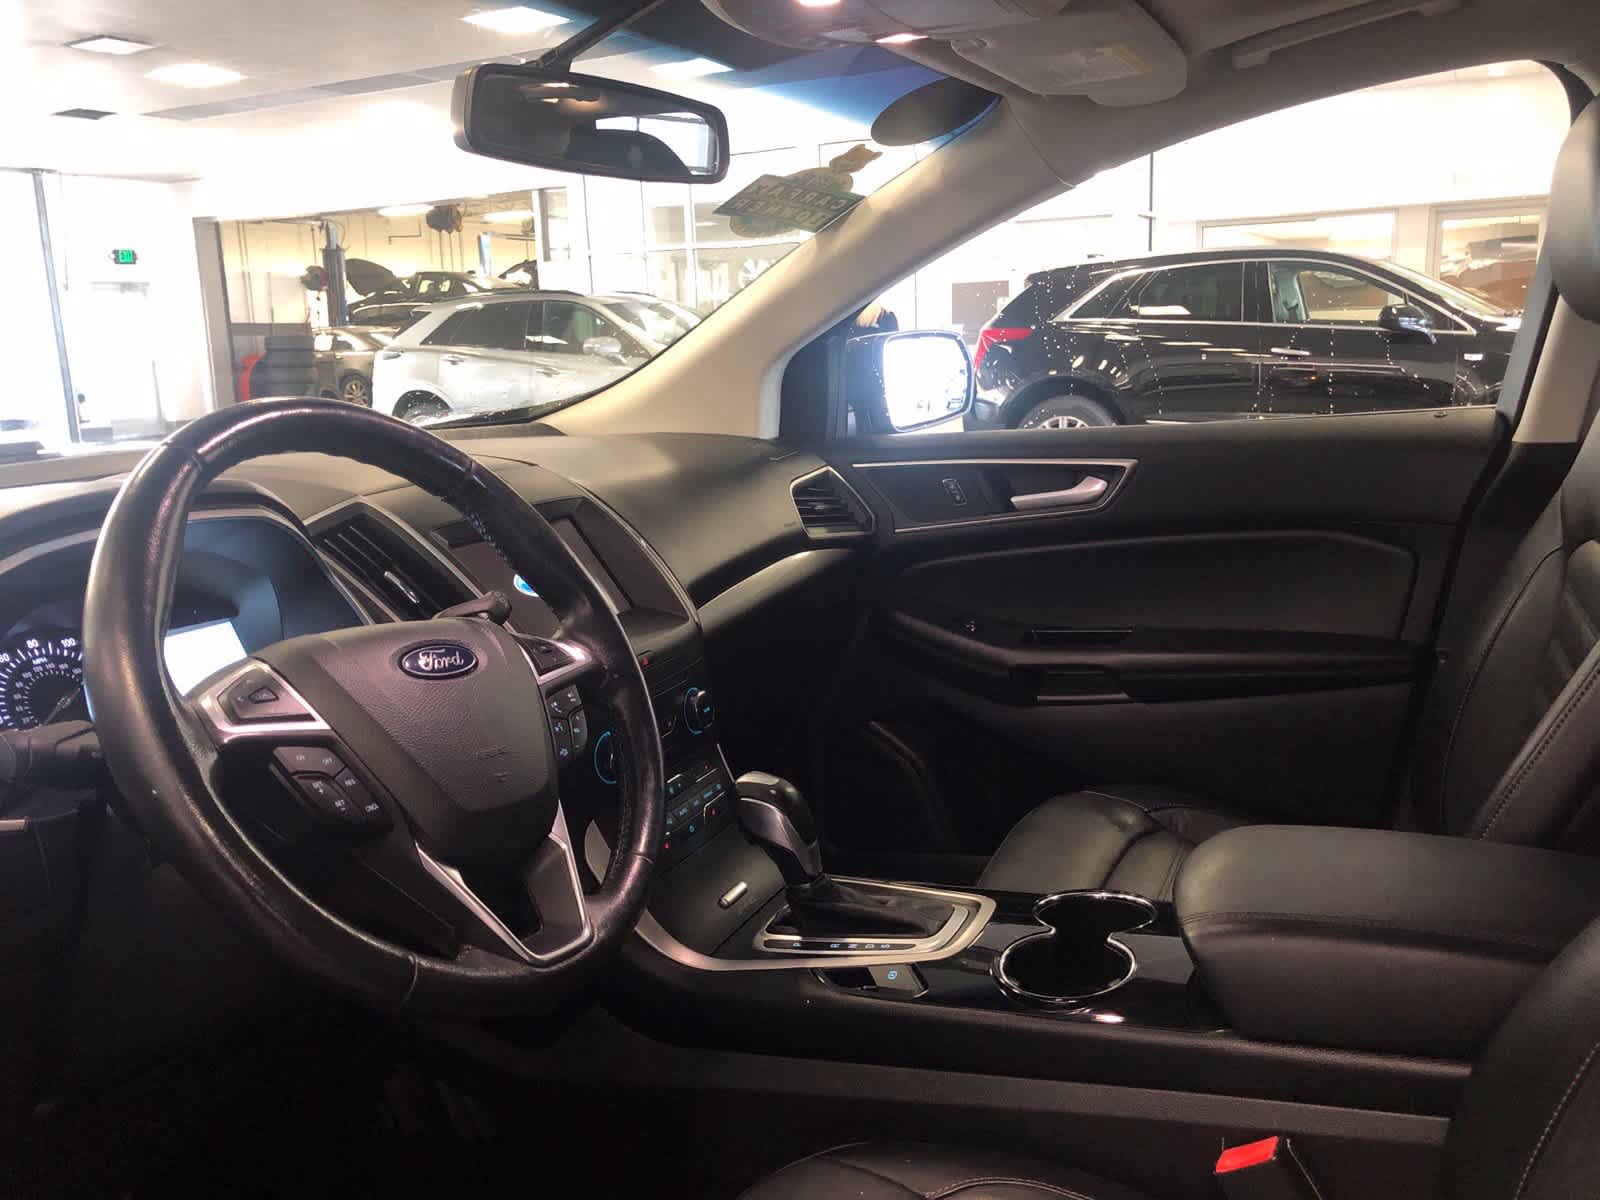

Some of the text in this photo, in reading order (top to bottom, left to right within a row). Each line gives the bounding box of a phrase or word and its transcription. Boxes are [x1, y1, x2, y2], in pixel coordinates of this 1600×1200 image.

[26, 639, 39, 649] 80
[61, 637, 76, 648] 100
[418, 648, 464, 671] Ford
